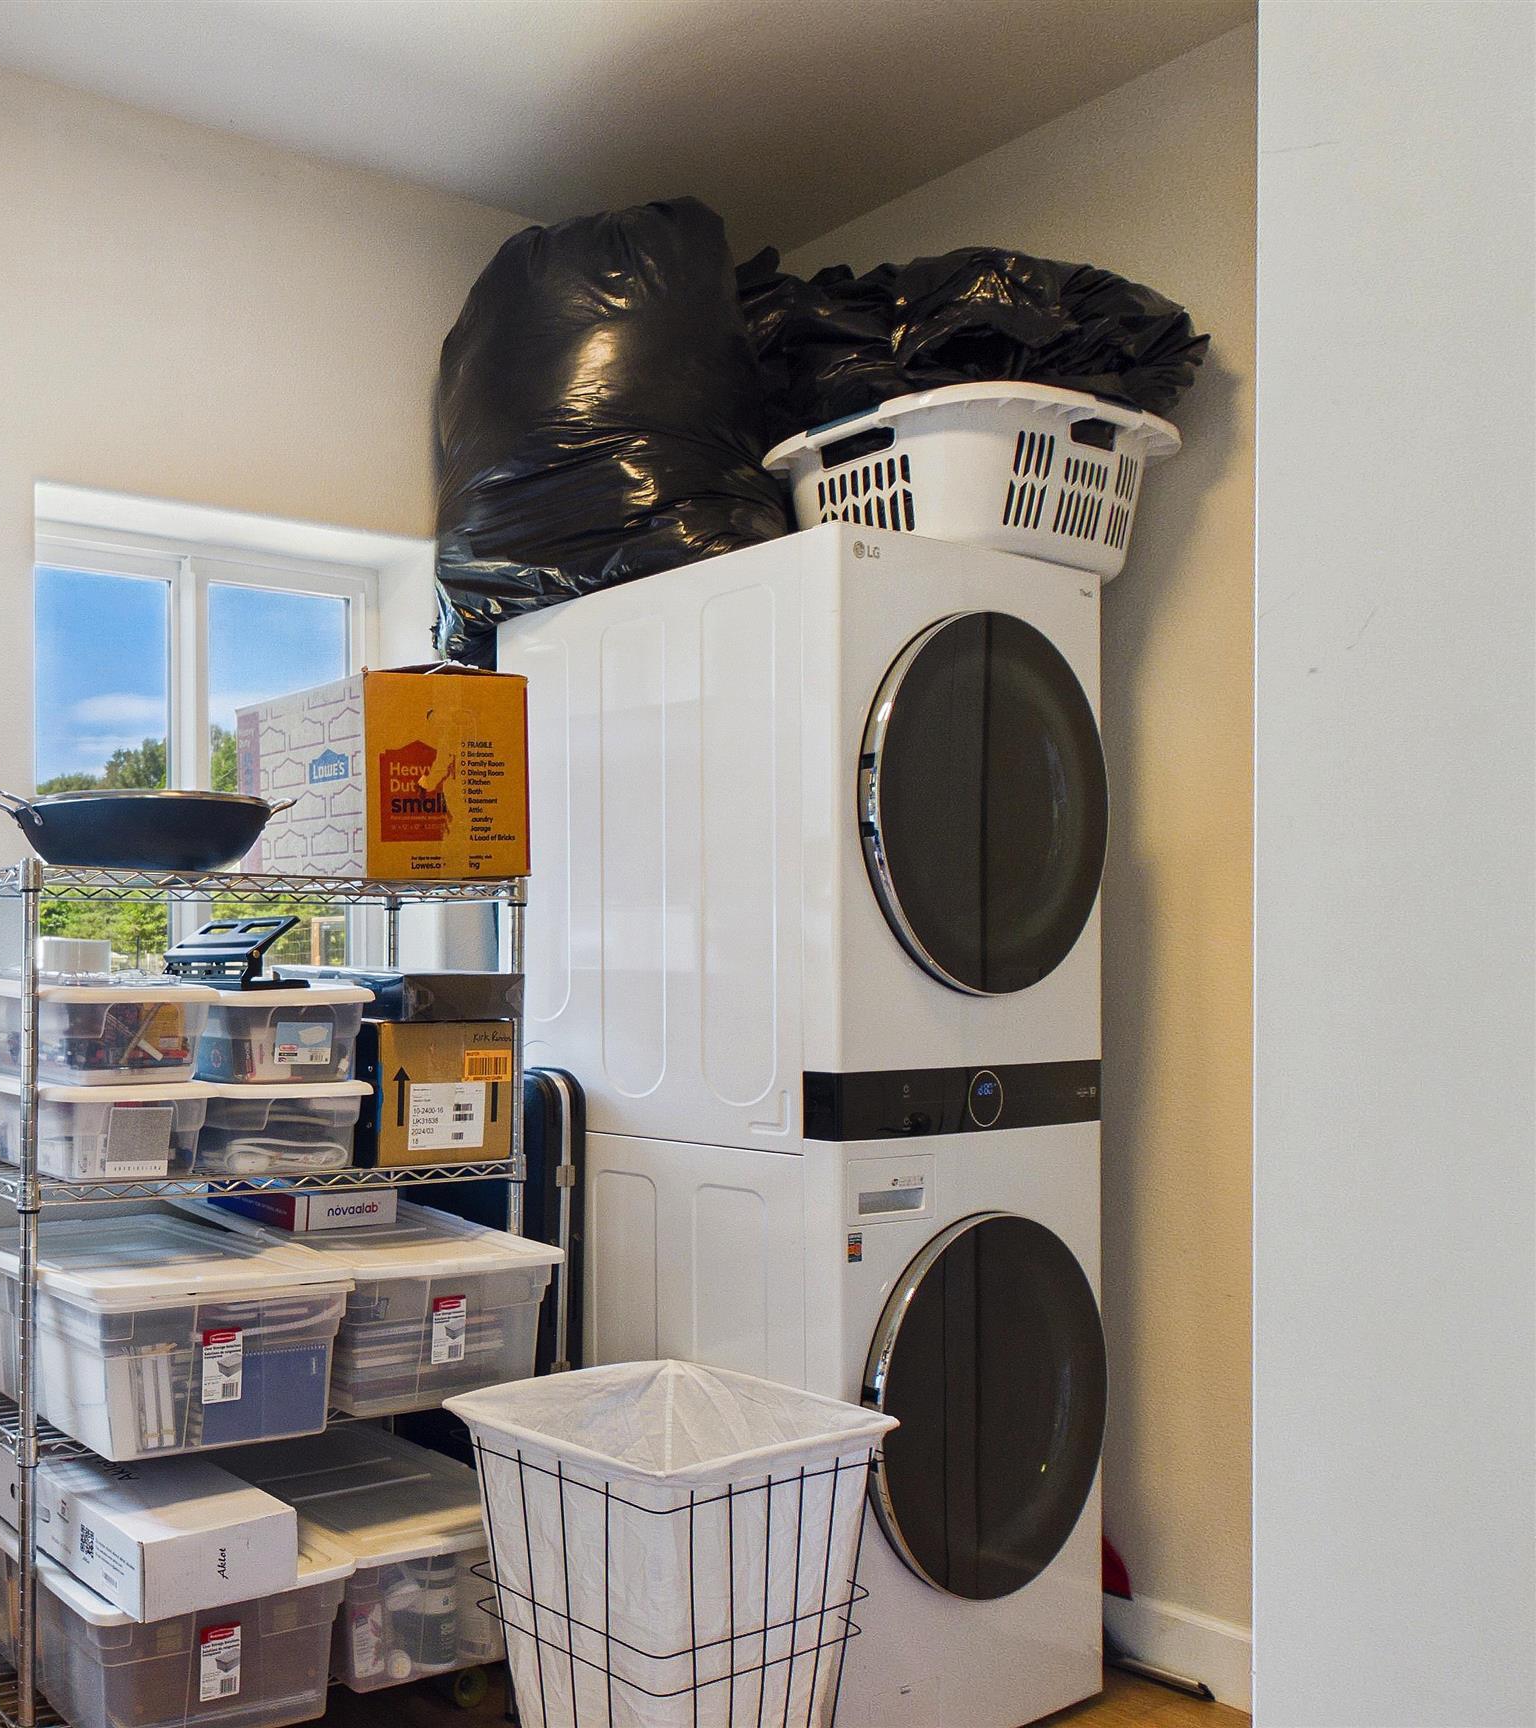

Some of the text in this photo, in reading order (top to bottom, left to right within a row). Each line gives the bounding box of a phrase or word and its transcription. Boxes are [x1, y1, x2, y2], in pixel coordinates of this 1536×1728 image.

[866, 545, 881, 559] LG
[312, 761, 345, 780] LOWE'S
[467, 761, 487, 769] Family
[467, 770, 486, 778] Dining
[390, 778, 418, 793] Dut
[471, 816, 494, 824] aundry
[217, 1547, 229, 1580] Aklot
